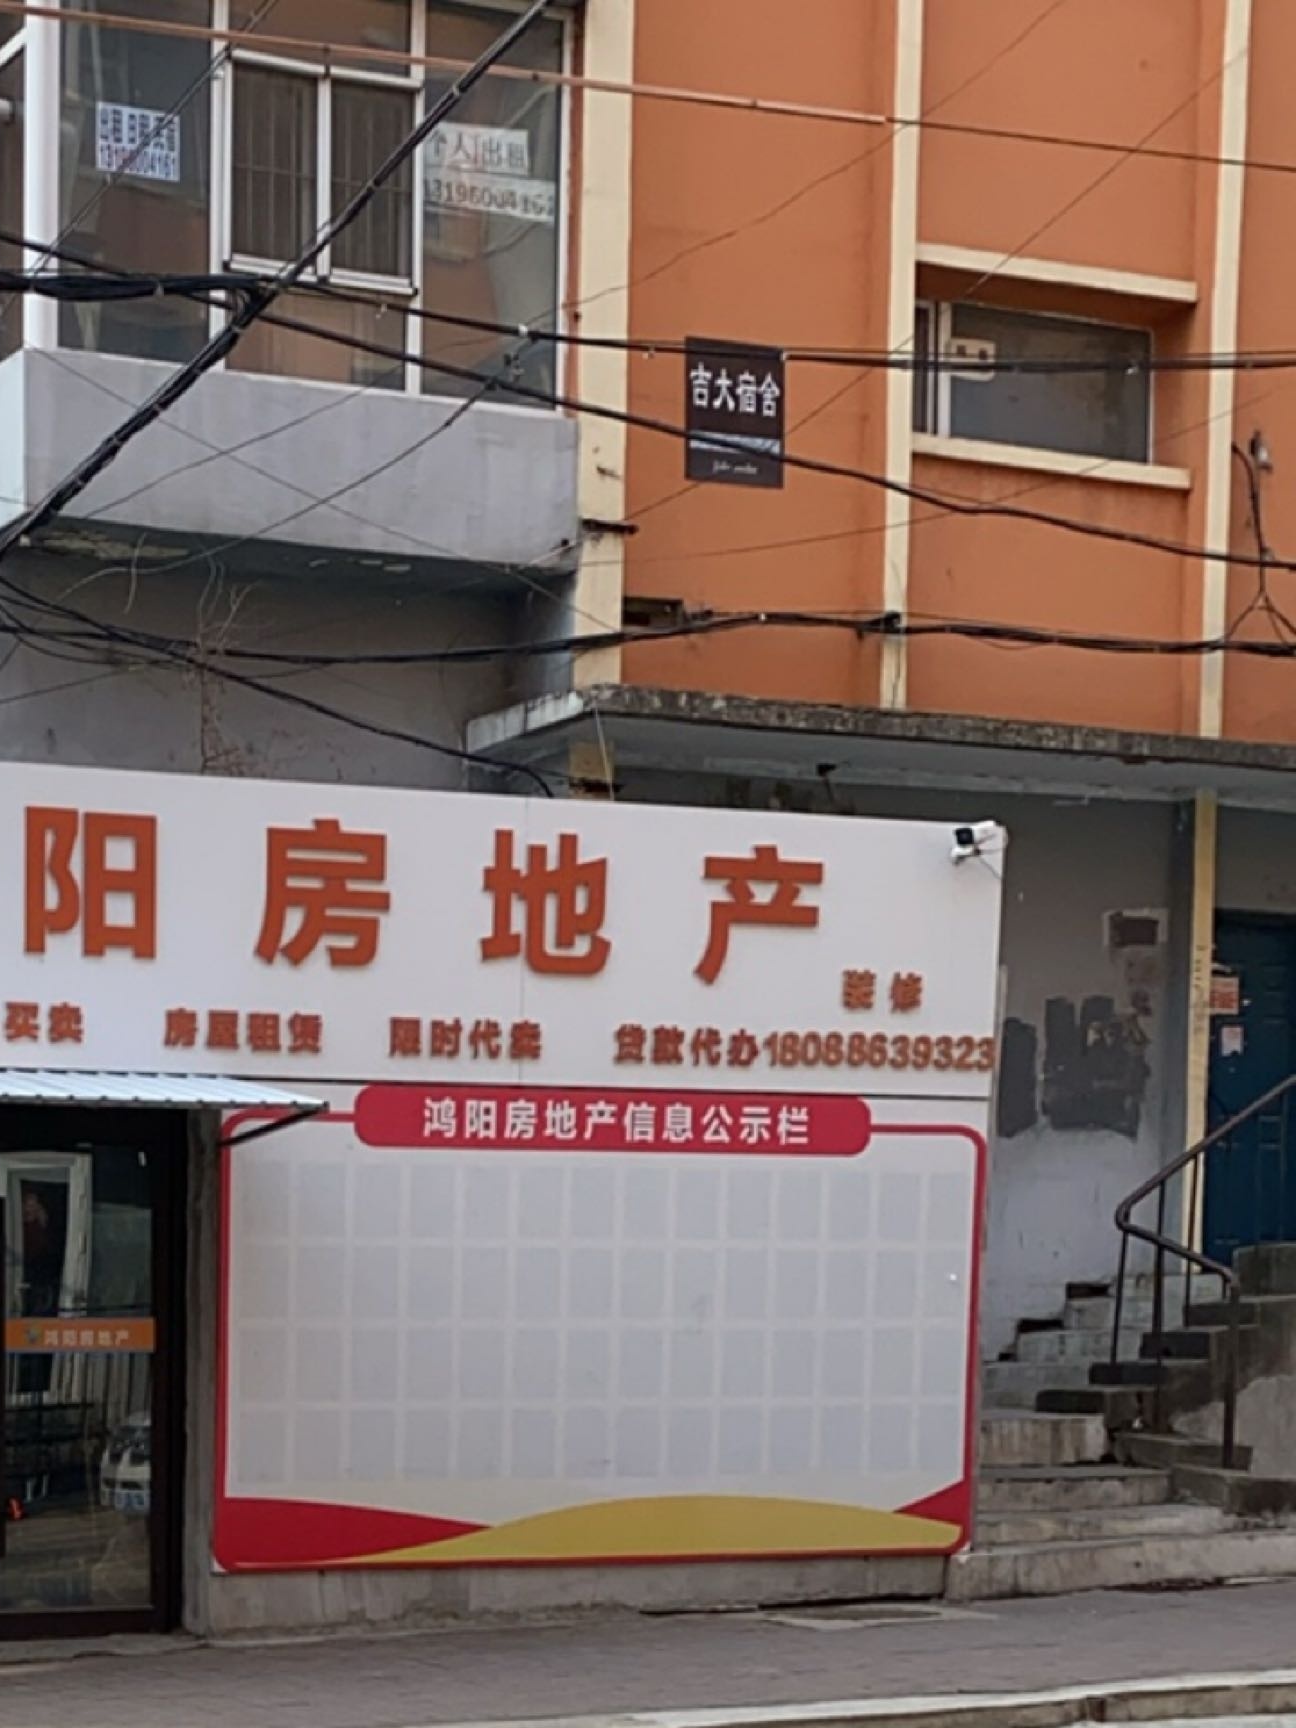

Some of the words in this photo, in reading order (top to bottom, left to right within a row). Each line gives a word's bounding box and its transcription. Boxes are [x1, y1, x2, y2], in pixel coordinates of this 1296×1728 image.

[689, 361, 780, 417] 吉大宿舍
[164, 1008, 322, 1053] 房屋租赁
[423, 1099, 810, 1145] 鸿阳房地产信息公示栏
